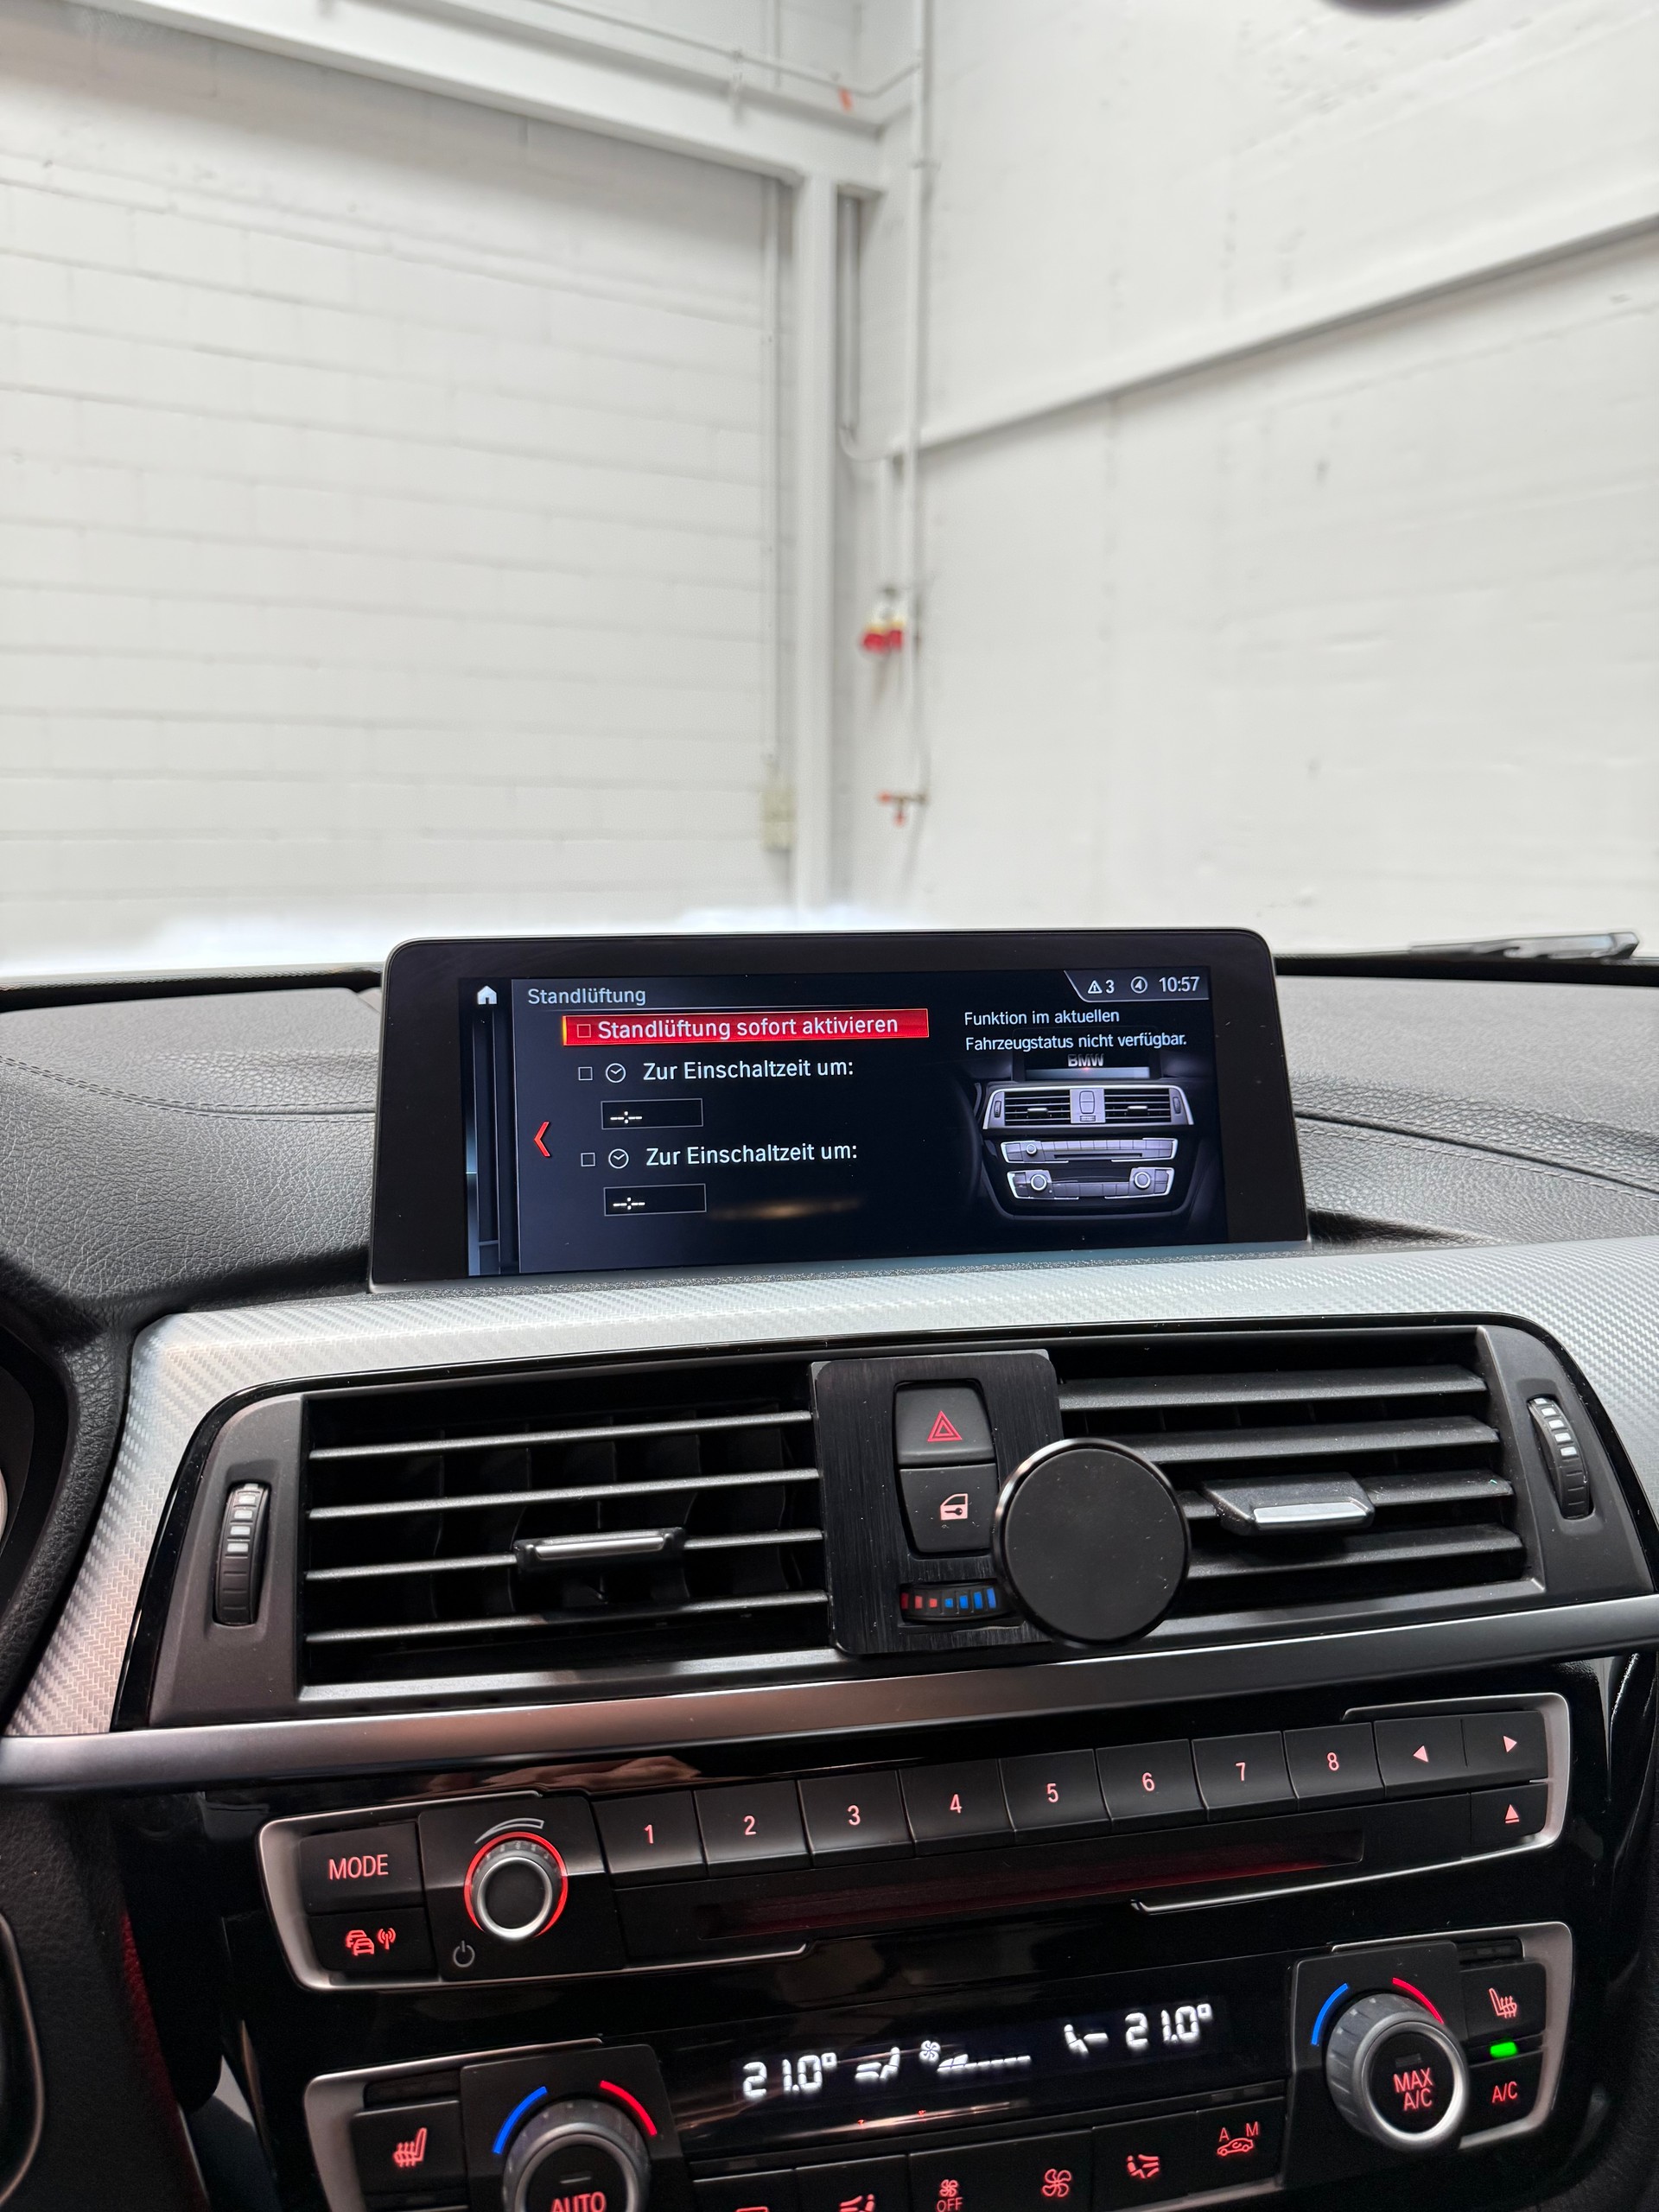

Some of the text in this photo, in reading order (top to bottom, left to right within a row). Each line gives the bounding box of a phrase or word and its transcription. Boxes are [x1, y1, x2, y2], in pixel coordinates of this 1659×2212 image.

[1105, 979, 1116, 994] 3
[1158, 976, 1200, 993] 10:57
[528, 988, 647, 1008] Standlüftung
[597, 1015, 899, 1040] Standlüftung sofort aktivieren
[964, 1008, 1121, 1026] Funktion im aktuellen
[965, 1032, 1187, 1052] Fahrzeugstatus nicht verfügbar.
[643, 1059, 855, 1082] Zur Einschaltzeit um:
[1067, 1053, 1105, 1068] BMW
[645, 1142, 858, 1167] Zur Einschaltzeit um:
[1235, 1761, 1248, 1783] 7
[1326, 1751, 1340, 1772] 8
[1141, 1771, 1155, 1793] 6
[1046, 1783, 1059, 1804] 5
[848, 1804, 861, 1826] 3
[949, 1794, 963, 1815] 4
[644, 1824, 655, 1845] 1
[743, 1815, 758, 1836] 2
[327, 1853, 389, 1881] MODE
[1393, 2067, 1434, 2093] MAX
[1403, 2088, 1433, 2111] A/C
[1491, 2081, 1519, 2104] A/C
[1218, 2120, 1260, 2142] A M
[550, 2190, 607, 2212] AUTO
[936, 2196, 963, 2212] OFF
